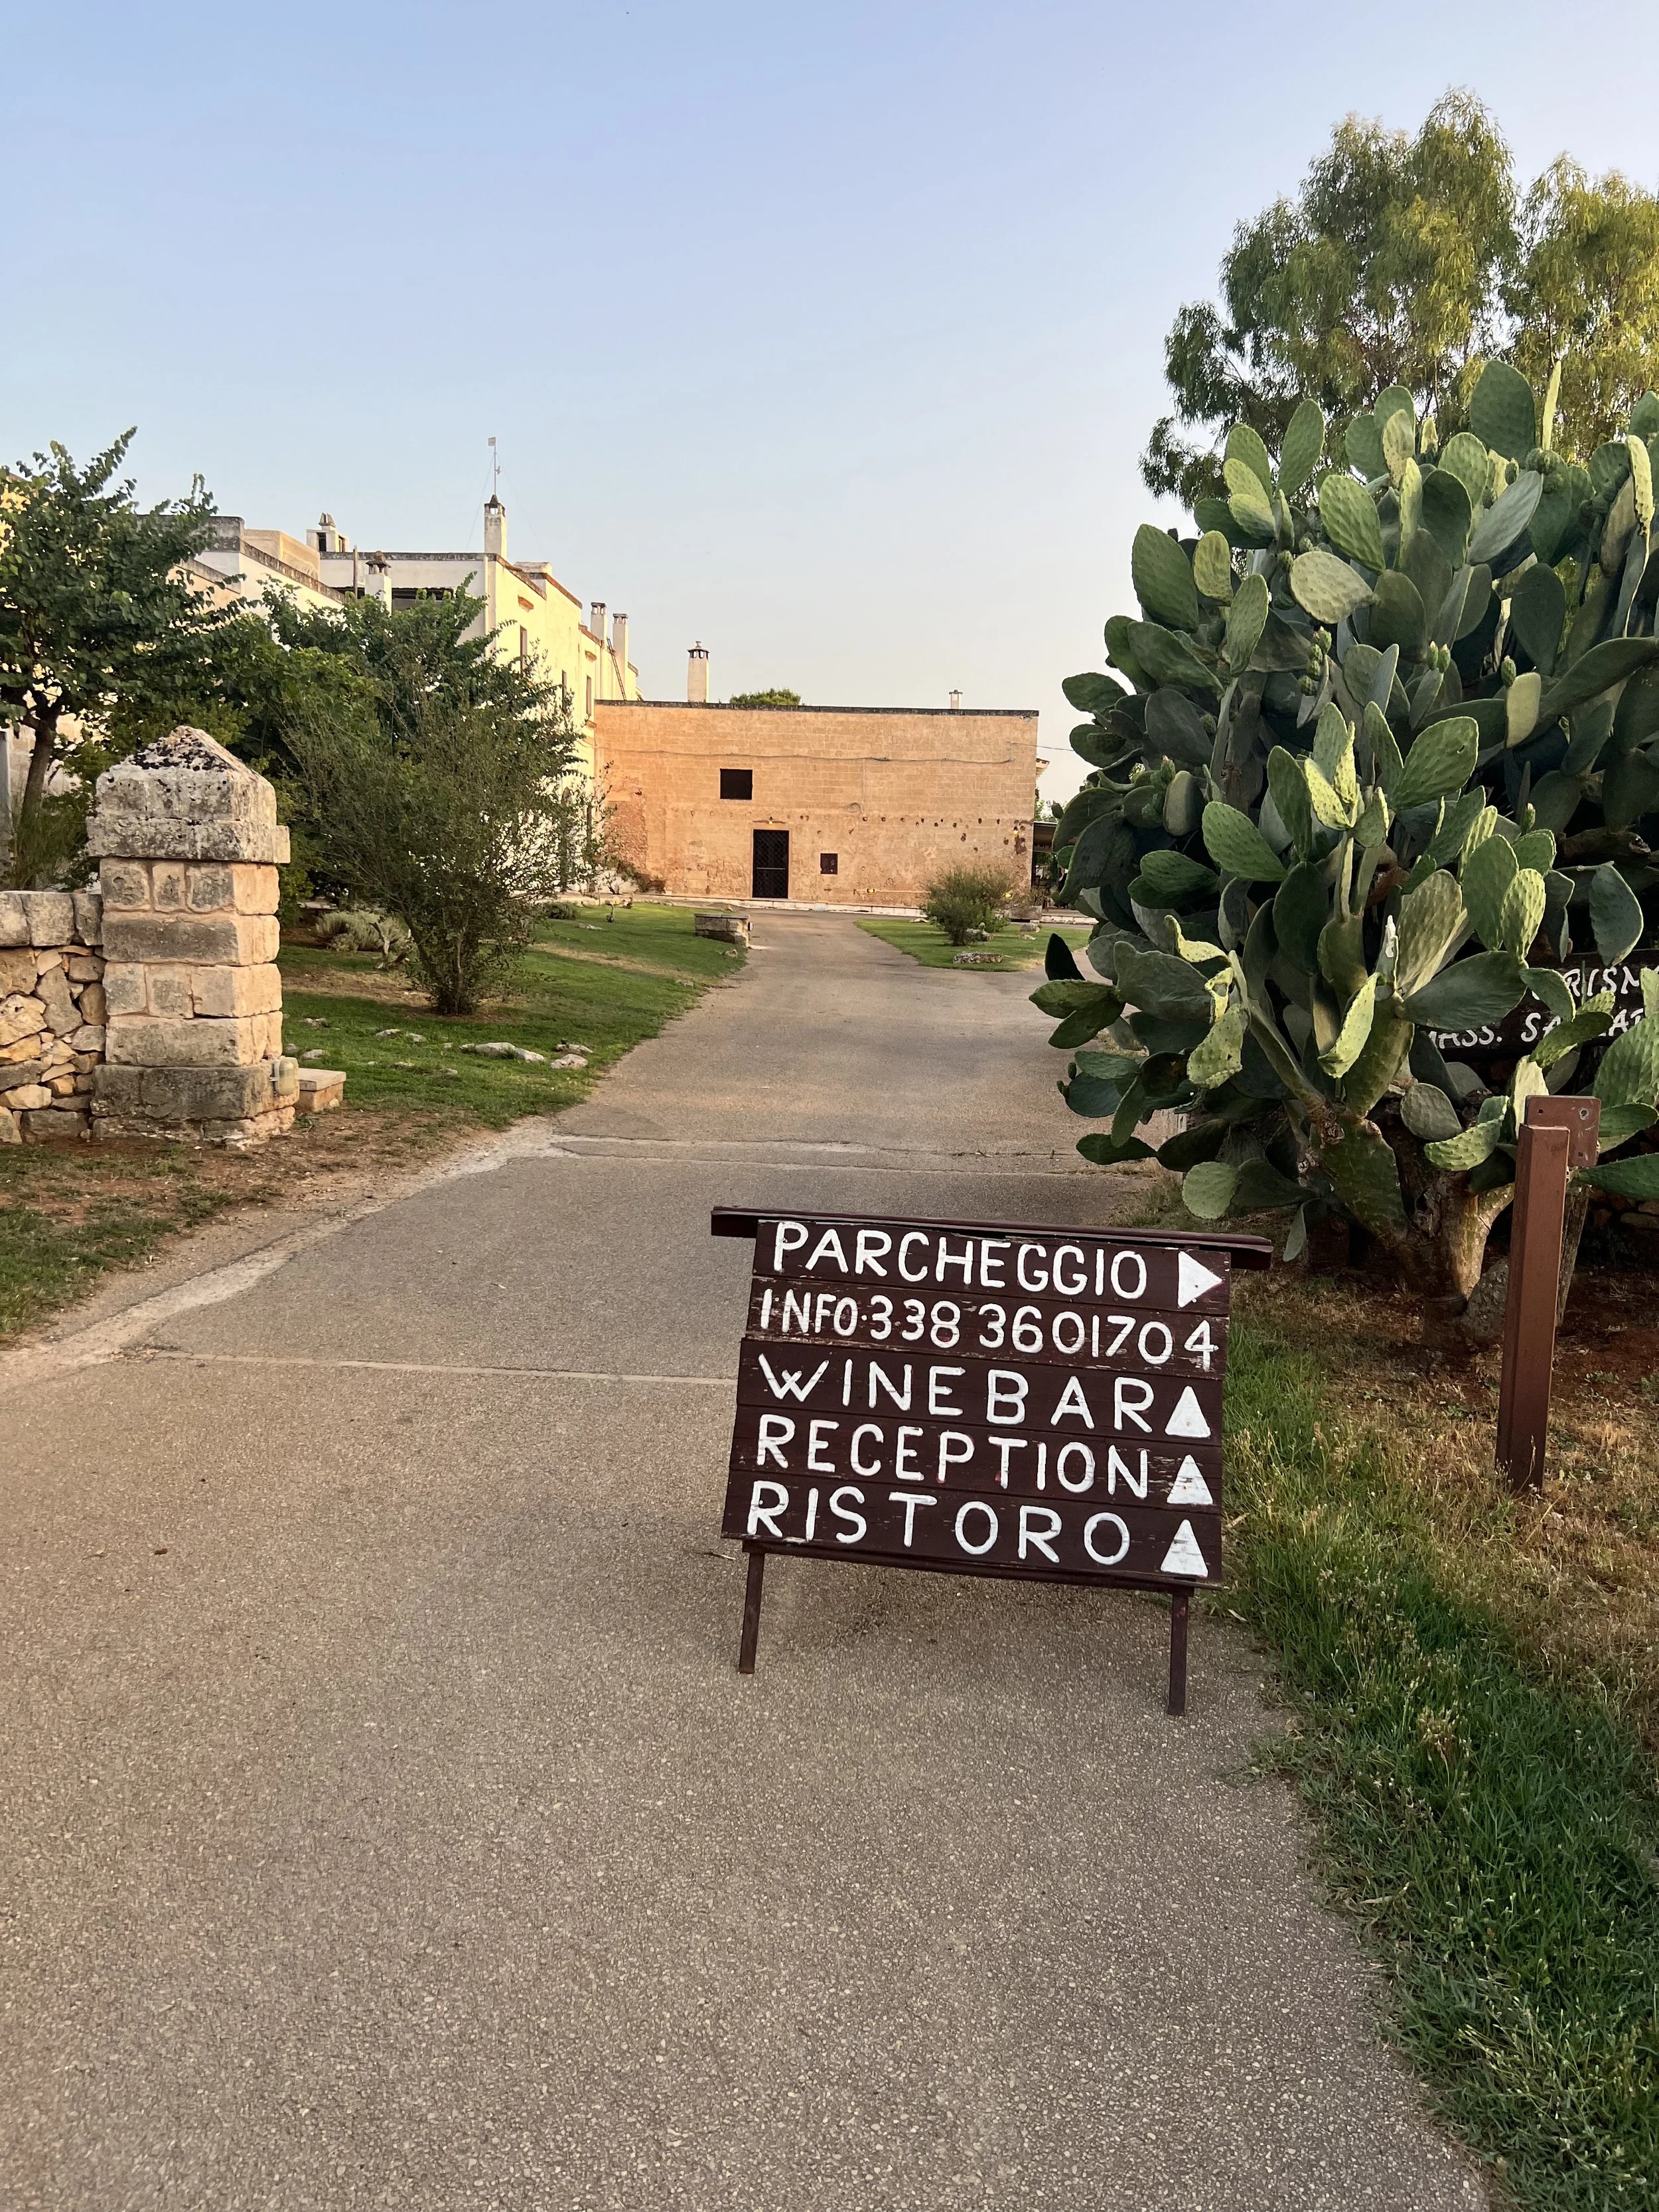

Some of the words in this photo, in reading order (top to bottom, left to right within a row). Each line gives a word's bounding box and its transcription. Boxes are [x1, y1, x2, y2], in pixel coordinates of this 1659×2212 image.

[773, 1220, 1147, 1299] PARCHEGGIO
[978, 1303, 1220, 1372] 3601704
[758, 1353, 966, 1416] WINE
[986, 1369, 1155, 1433] BAR
[757, 1414, 1148, 1499] RECEPTION
[747, 1480, 1130, 1565] RISTORO
